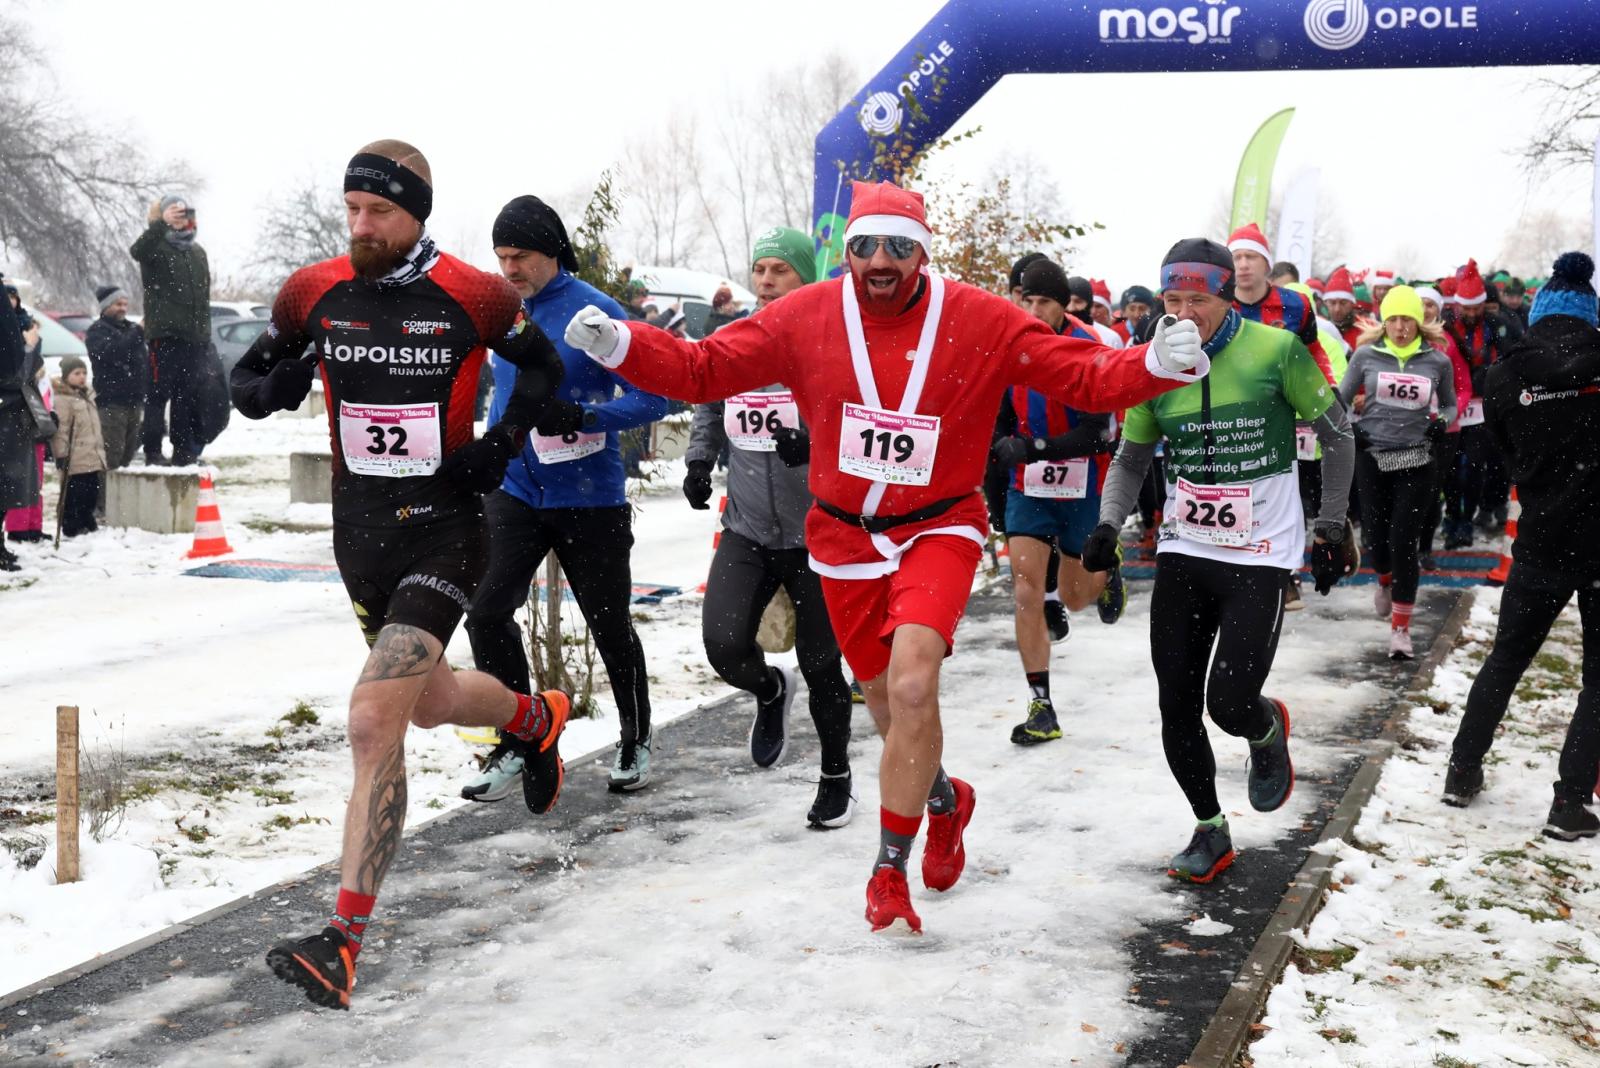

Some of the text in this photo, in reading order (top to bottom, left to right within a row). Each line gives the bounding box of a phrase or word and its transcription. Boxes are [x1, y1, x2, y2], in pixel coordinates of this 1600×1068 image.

[1375, 6, 1478, 30] OPOLE
[898, 40, 954, 98] OPOLE
[402, 320, 451, 330] COMPRES
[334, 344, 452, 364] OPOLSKIE
[1388, 383, 1419, 400] 165
[1532, 390, 1579, 402] Zmierzymy
[736, 409, 783, 435] 196
[1187, 417, 1267, 432] Dyrektor Biega
[366, 425, 409, 456] 32
[860, 428, 915, 463] 119
[1216, 428, 1265, 444] po Windę
[1207, 441, 1265, 456] Dzieciaków
[1042, 465, 1069, 485] 87
[1185, 499, 1237, 529] 226
